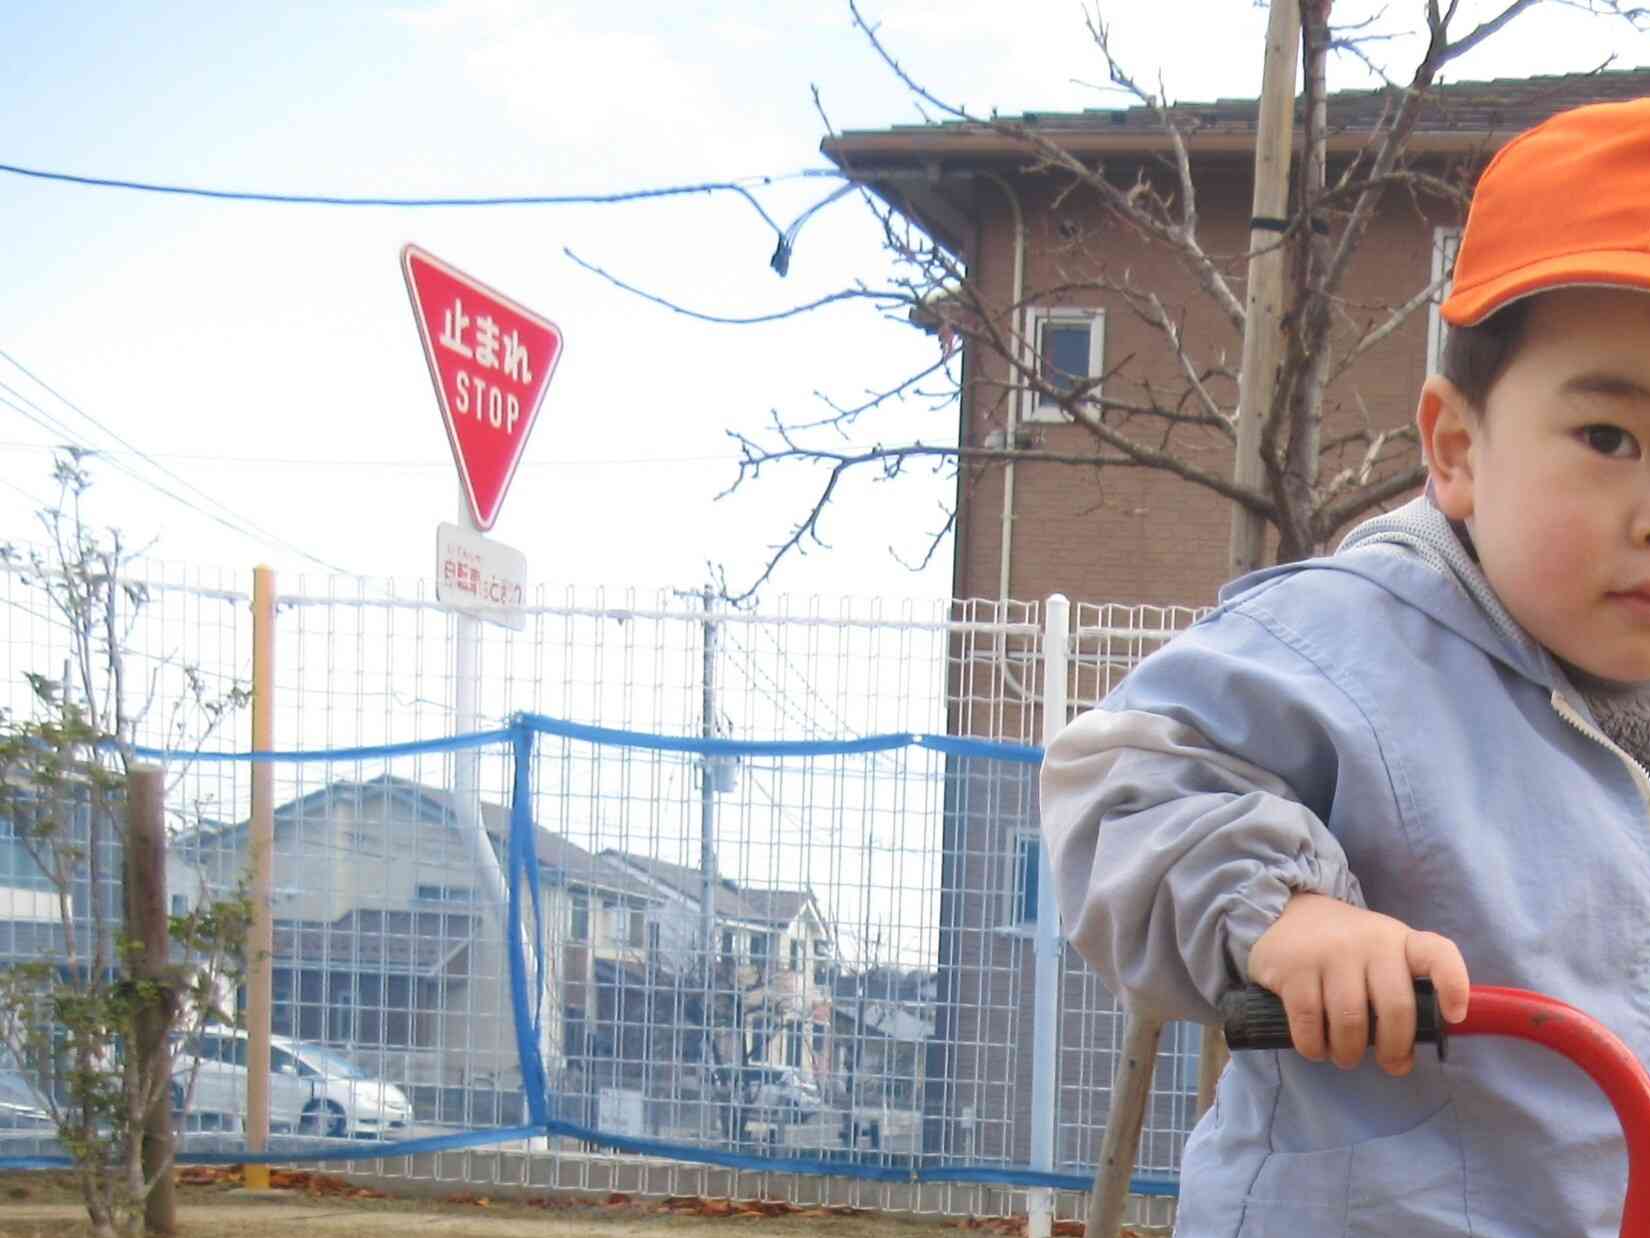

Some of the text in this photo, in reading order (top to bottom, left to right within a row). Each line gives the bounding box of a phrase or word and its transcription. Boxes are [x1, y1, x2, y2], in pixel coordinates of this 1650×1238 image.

[440, 298, 532, 384] 止まれ
[456, 370, 519, 434] STOP
